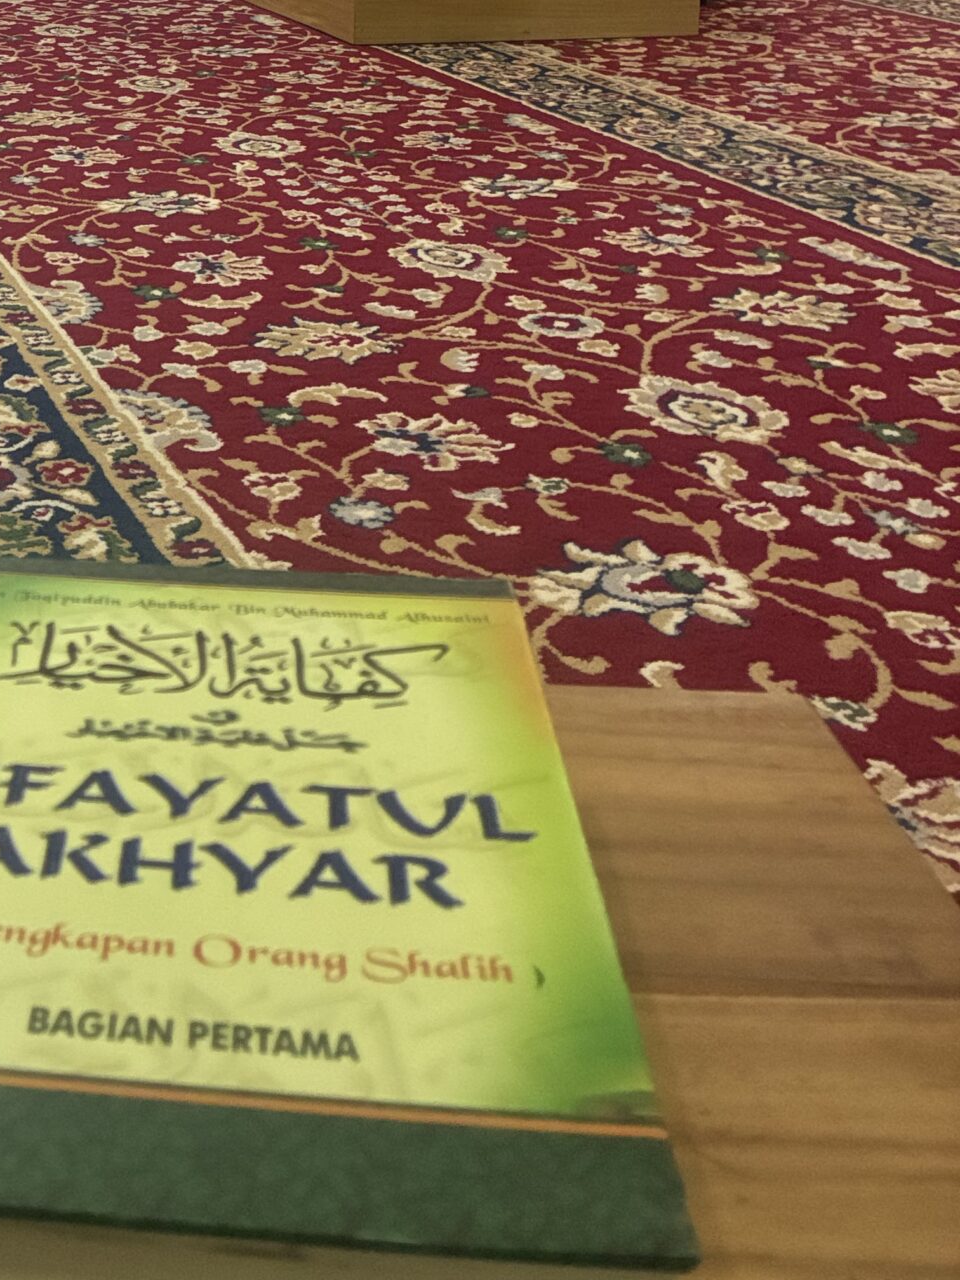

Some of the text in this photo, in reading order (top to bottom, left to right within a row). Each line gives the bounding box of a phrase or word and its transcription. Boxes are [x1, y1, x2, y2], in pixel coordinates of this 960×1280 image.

[229, 603, 266, 616] Bin
[274, 606, 388, 621] Muhammad
[192, 932, 349, 984] Orang
[361, 946, 515, 985] Shalih
[27, 1005, 361, 1064] BAGIAN PERTAMA
